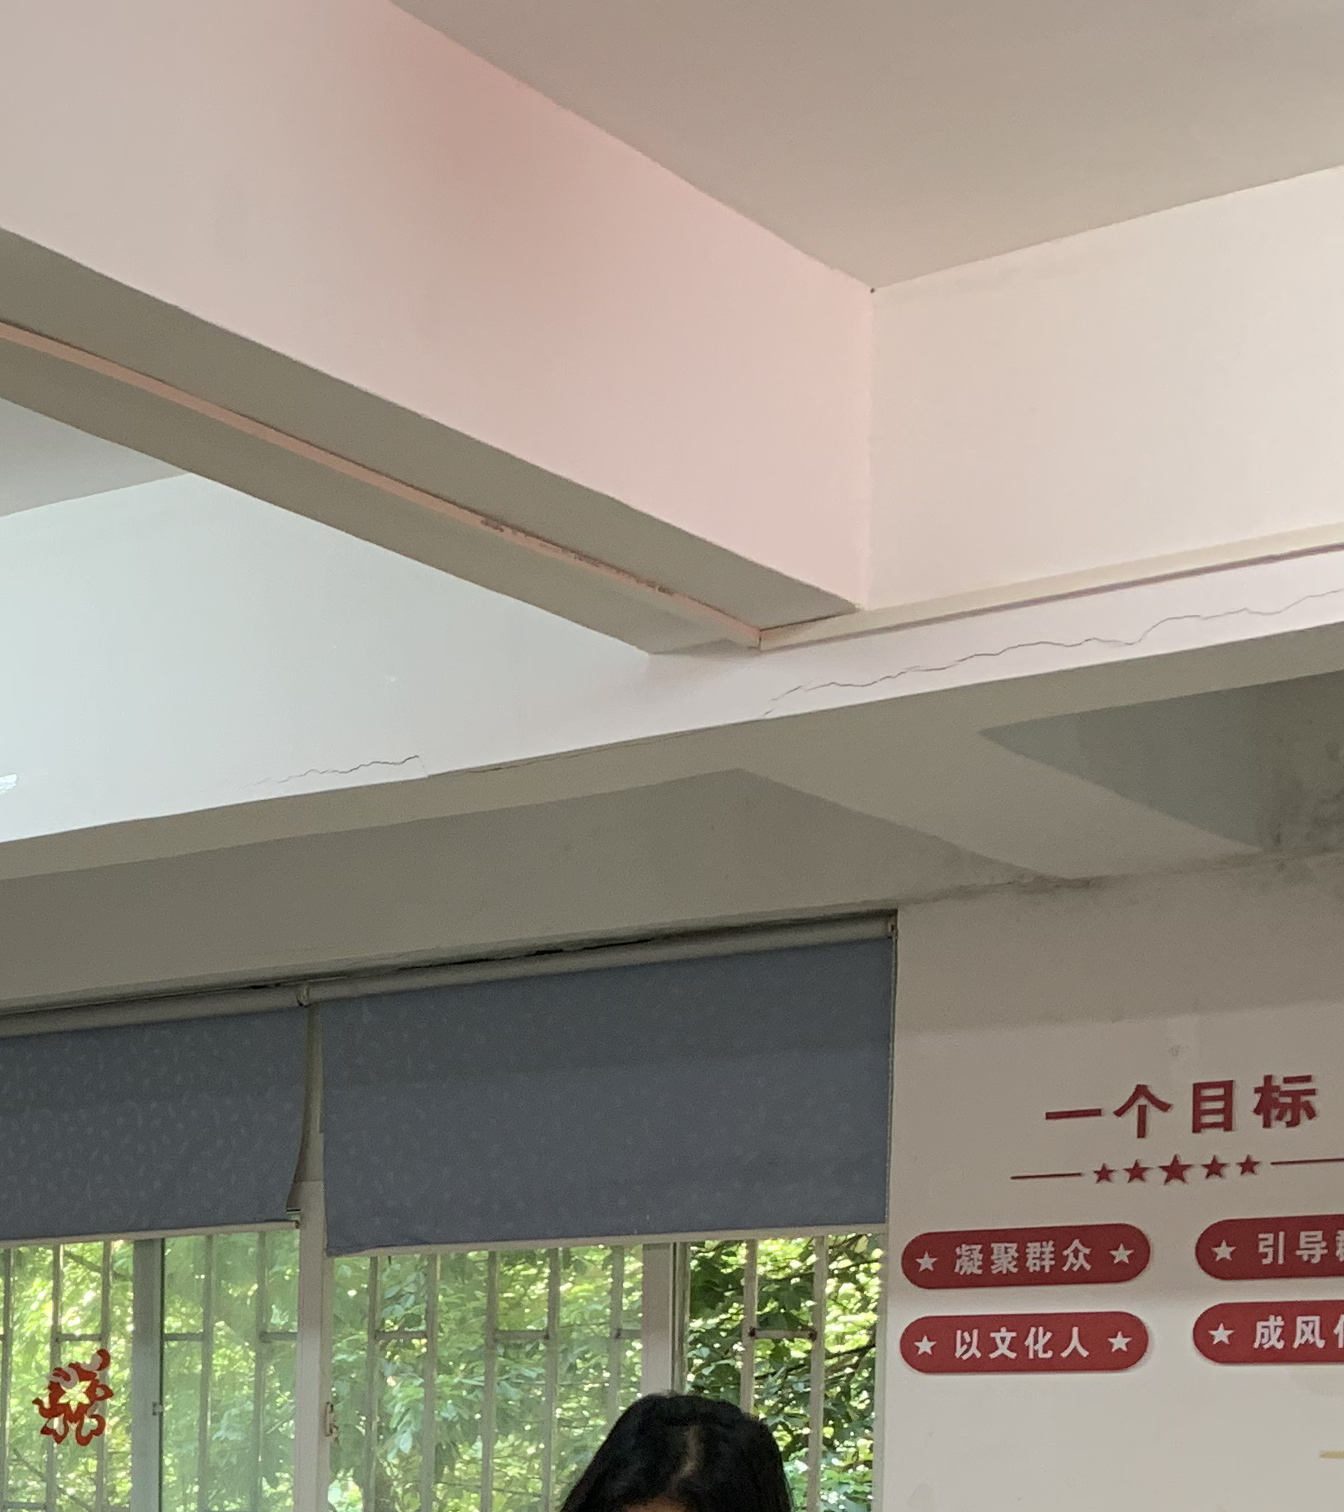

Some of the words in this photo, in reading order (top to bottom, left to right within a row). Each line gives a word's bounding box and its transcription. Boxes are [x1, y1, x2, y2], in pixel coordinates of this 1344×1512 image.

[1045, 1074, 1318, 1139] 一个目标
[953, 1238, 1093, 1276] 凝聚群众
[1257, 1229, 1344, 1265] 引导
[953, 1326, 1091, 1360] 以文化人
